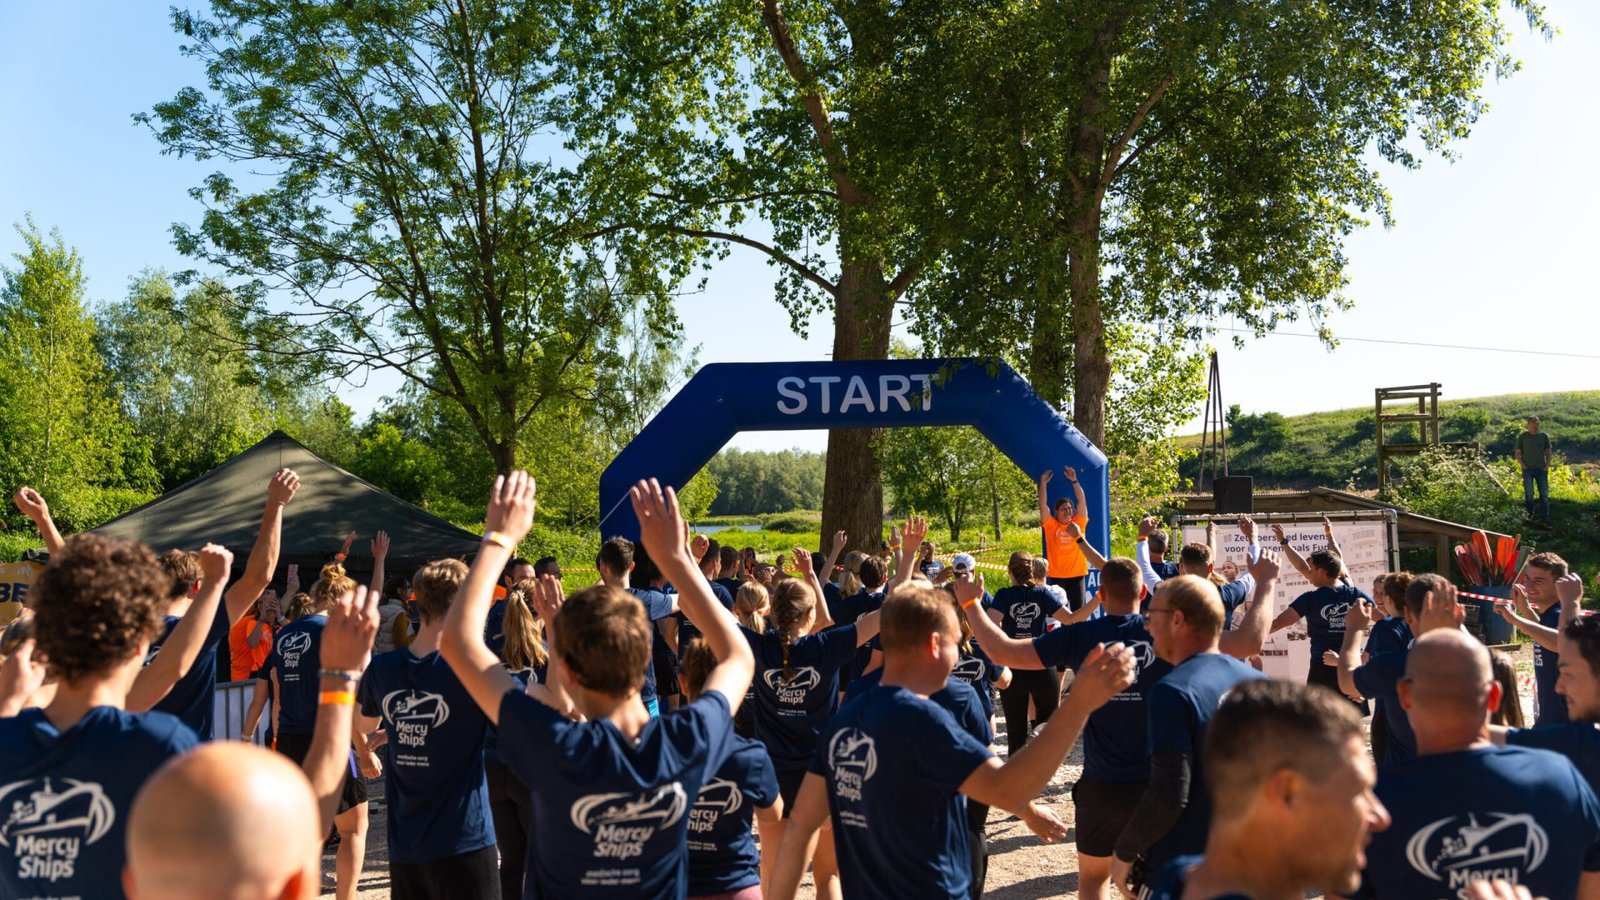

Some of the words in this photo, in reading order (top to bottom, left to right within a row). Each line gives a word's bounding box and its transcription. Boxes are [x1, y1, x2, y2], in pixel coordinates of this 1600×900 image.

[776, 374, 938, 415] START
[396, 720, 428, 736] Mercy
[398, 732, 425, 748] Ships
[835, 766, 862, 789] Mercy
[836, 781, 862, 802] Ships
[686, 817, 714, 833] hips
[689, 808, 718, 823] ercy
[594, 823, 655, 844] Mercy
[15, 834, 80, 860] Mercy
[18, 856, 75, 882] Ships
